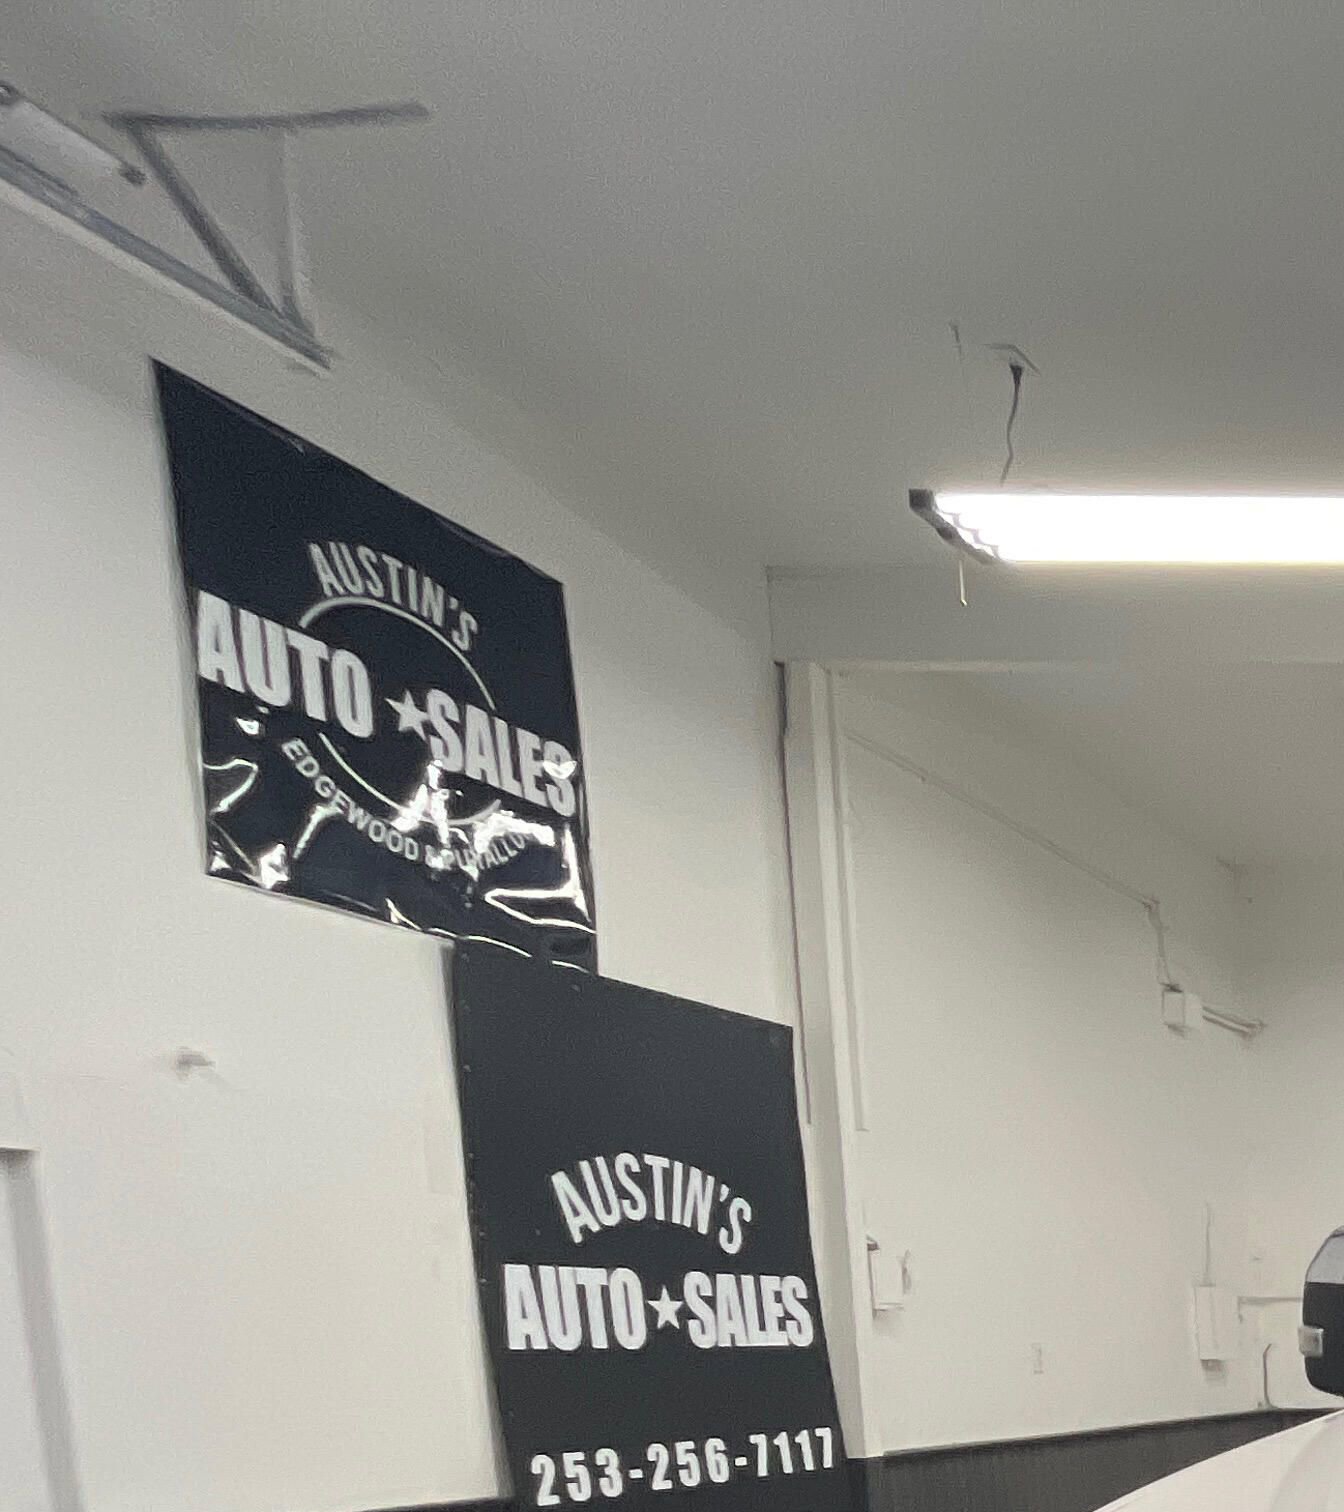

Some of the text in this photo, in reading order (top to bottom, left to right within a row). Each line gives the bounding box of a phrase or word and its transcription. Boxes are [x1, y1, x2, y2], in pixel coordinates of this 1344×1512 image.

[307, 541, 480, 651] AUSTIN'S
[199, 589, 577, 817] AUTO SALES
[281, 737, 420, 861] EDGEWOOD
[551, 1151, 752, 1254] AUSTIN'S
[503, 1263, 814, 1351] AUTO SALES
[530, 1426, 836, 1507] 253-256-7117
